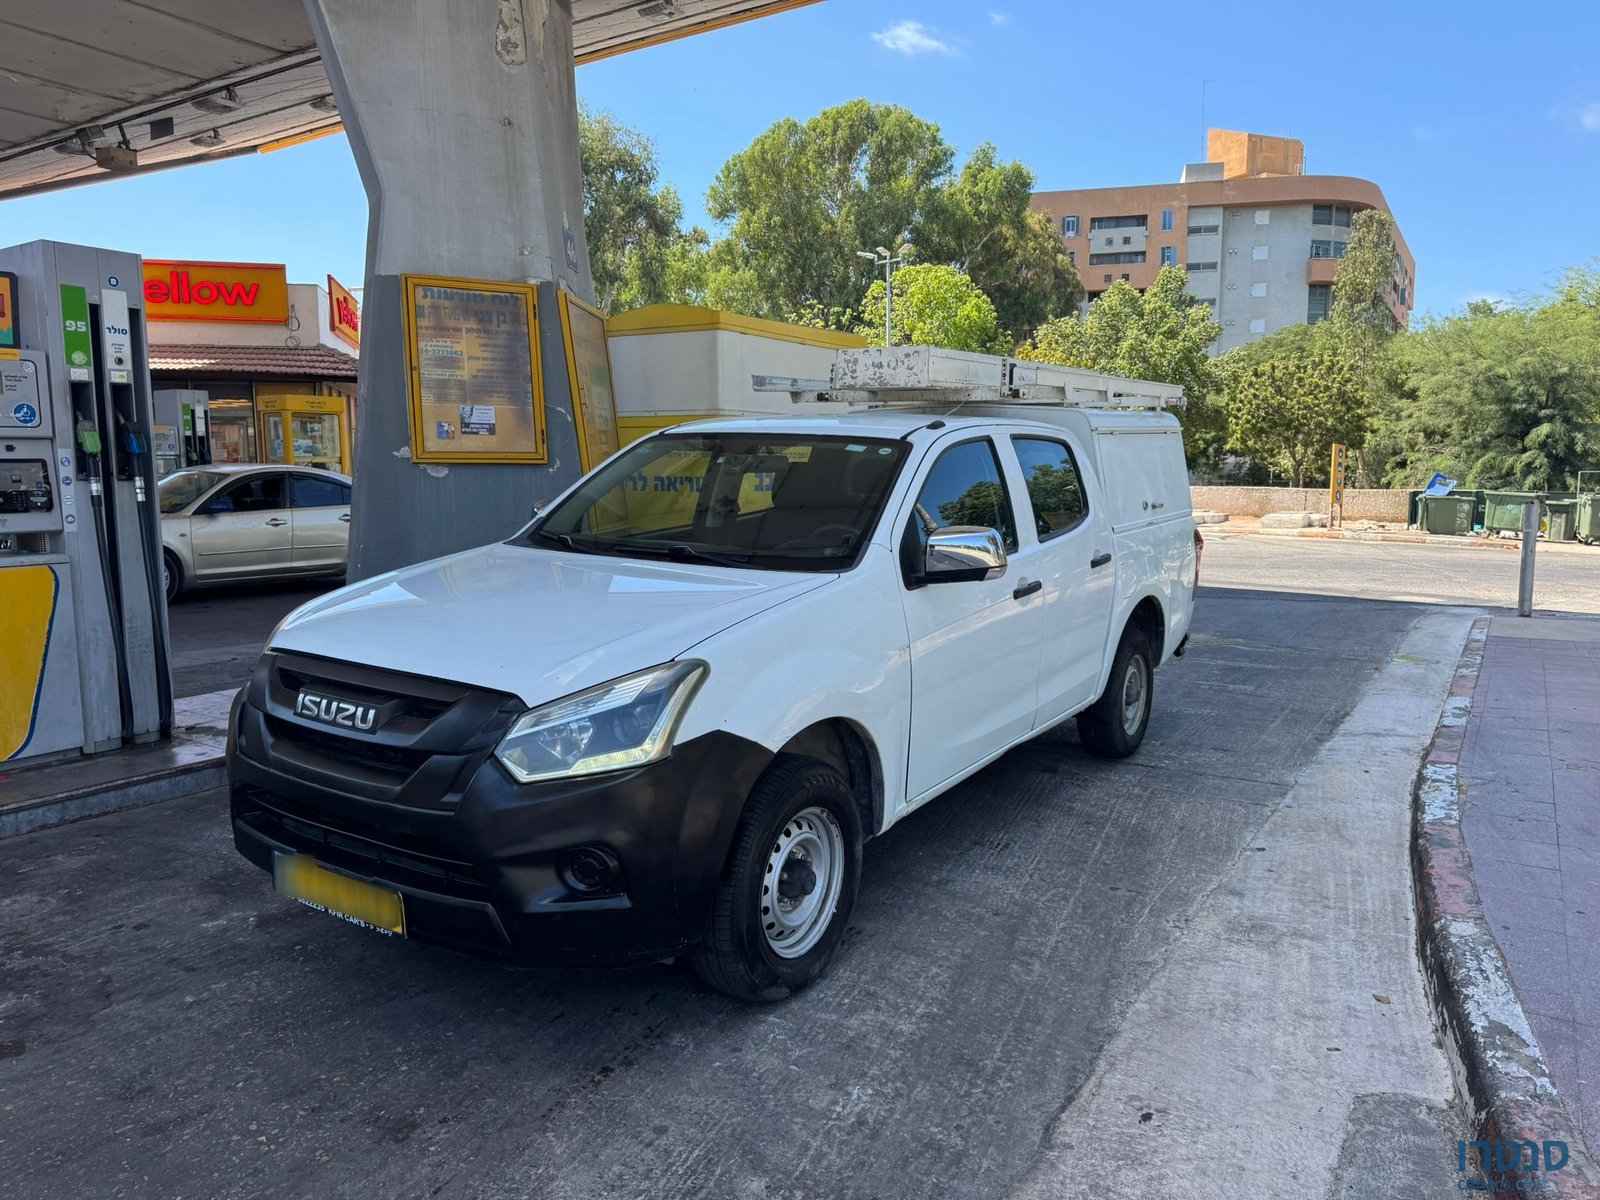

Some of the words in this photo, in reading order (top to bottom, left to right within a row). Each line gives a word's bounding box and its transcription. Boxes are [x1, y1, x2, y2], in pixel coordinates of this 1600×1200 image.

[65, 319, 87, 332] 95
[106, 325, 128, 335] סולר
[295, 693, 376, 730] ISUZU
